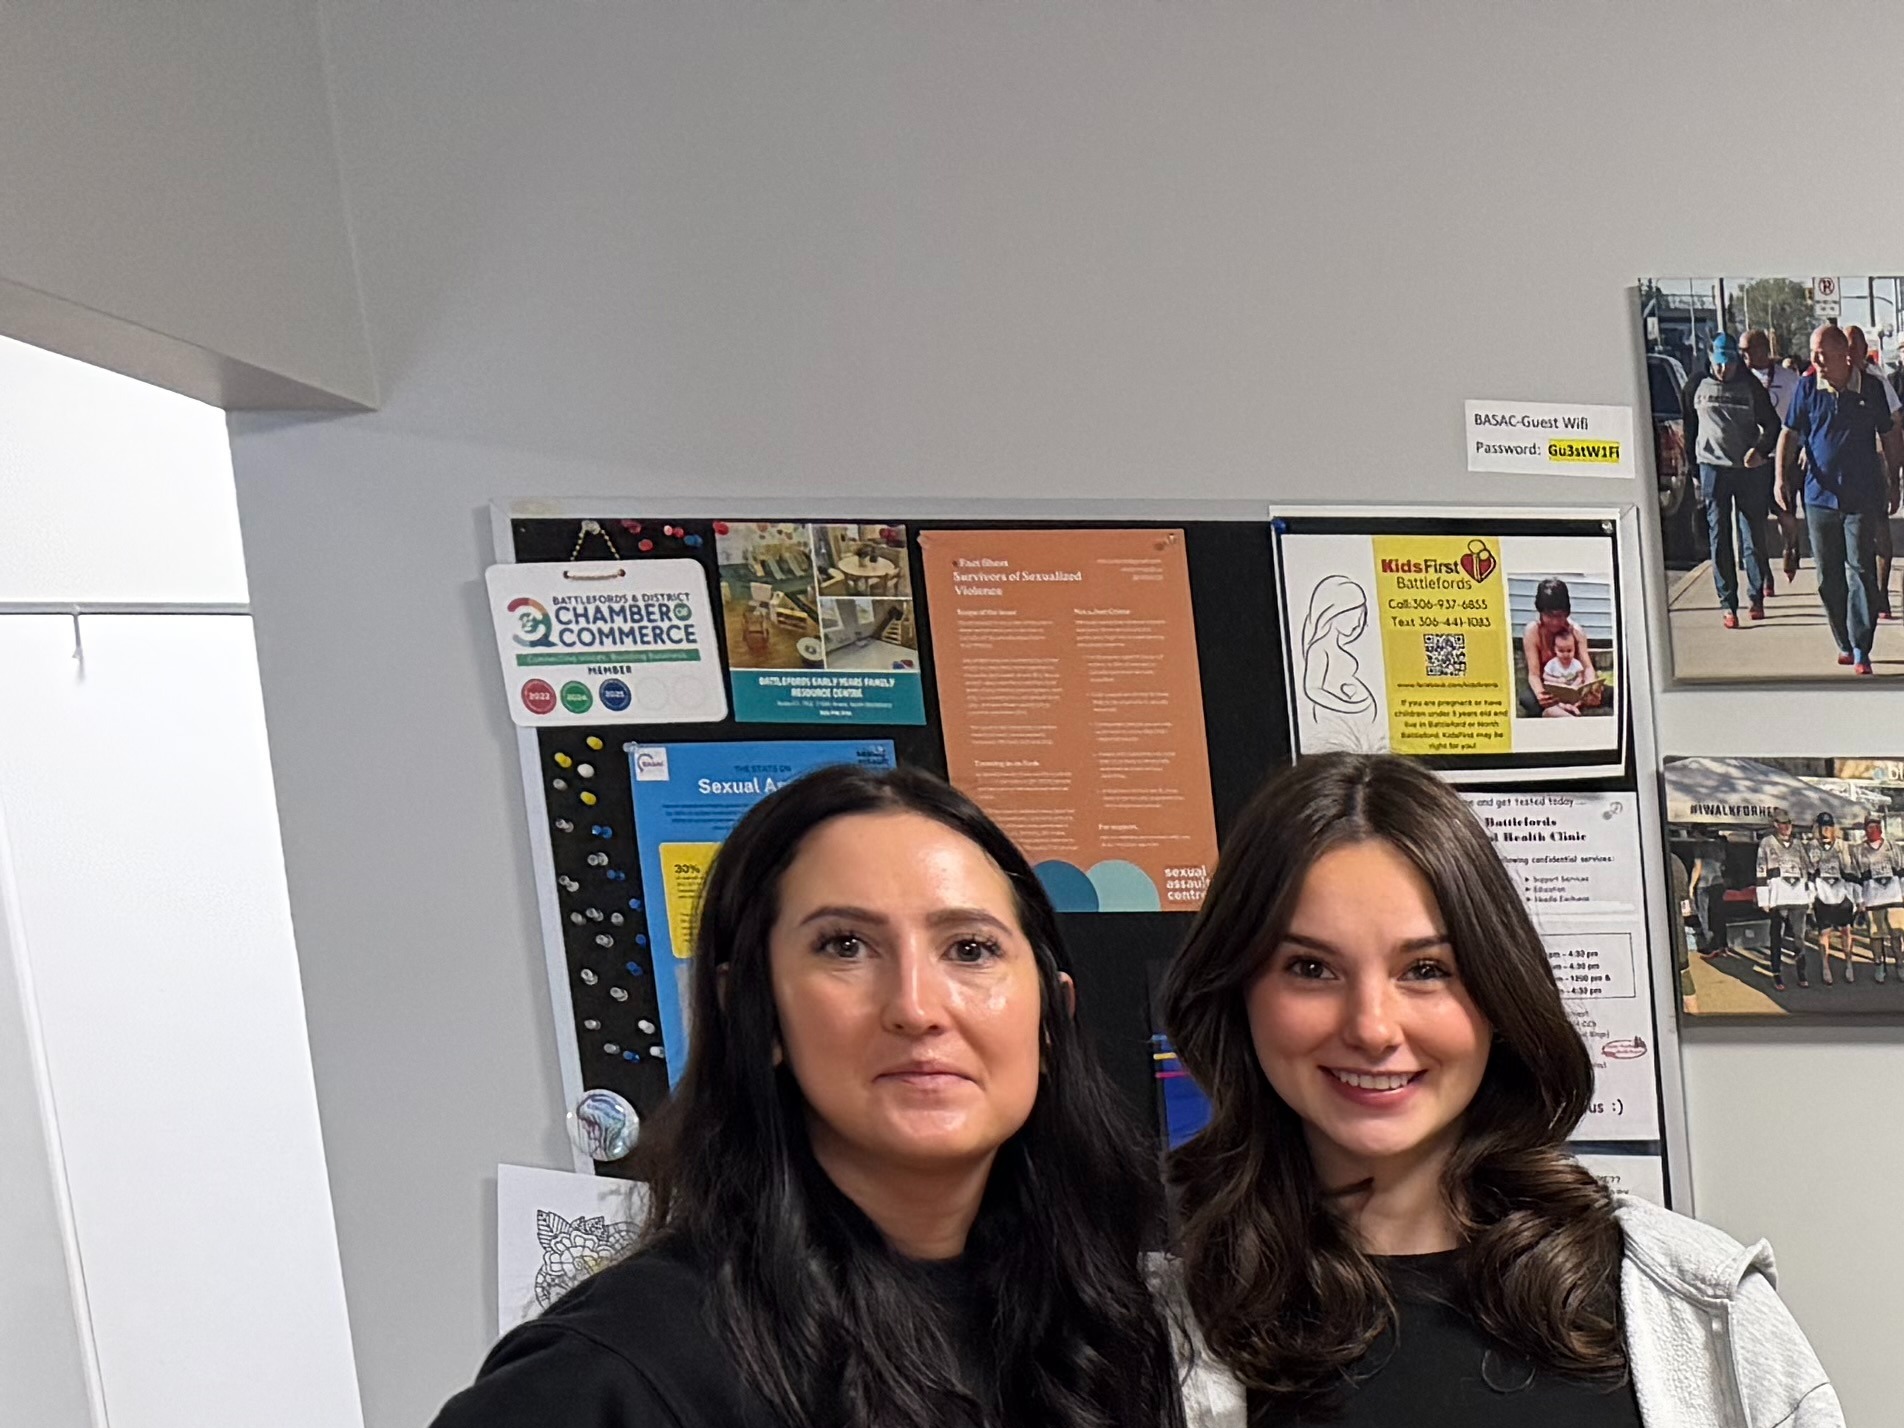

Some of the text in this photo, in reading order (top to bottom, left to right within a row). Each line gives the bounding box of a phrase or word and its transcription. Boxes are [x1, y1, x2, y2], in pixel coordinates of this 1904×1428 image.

[1475, 413, 1558, 429] BASAC-Guest
[1476, 442, 1541, 455] Password:
[959, 559, 980, 567] Fact
[1381, 559, 1460, 574] KidsFirst
[954, 570, 1082, 581] Survivors of Sexualized
[1397, 576, 1472, 590] Battlefords
[955, 586, 1003, 596] Violence
[553, 593, 691, 606] BATTLEFORDS & DISTRICT
[555, 603, 671, 625] CHAMBER
[1391, 617, 1415, 626] Text
[559, 624, 698, 647] COMMERCE
[588, 665, 632, 675] MEMBER
[759, 677, 810, 686] BATTLEFORDS
[864, 678, 895, 687] FAMILY
[791, 688, 863, 698] RESOURCE CENTRE
[752, 764, 774, 772] STATS
[698, 779, 760, 794] Sexual
[1496, 799, 1511, 809] get
[1515, 798, 1545, 806] tested
[1549, 798, 1574, 809] today
[1485, 817, 1557, 828] Battlefords
[1504, 832, 1587, 842] Health Clinic
[1532, 855, 1577, 864] confidential
[1165, 865, 1207, 878] sexual
[1166, 877, 1211, 890] assault
[1587, 951, 1598, 959] pm
[1588, 963, 1599, 971] pm
[1589, 987, 1602, 995] pm
[1589, 1104, 1604, 1114] us
